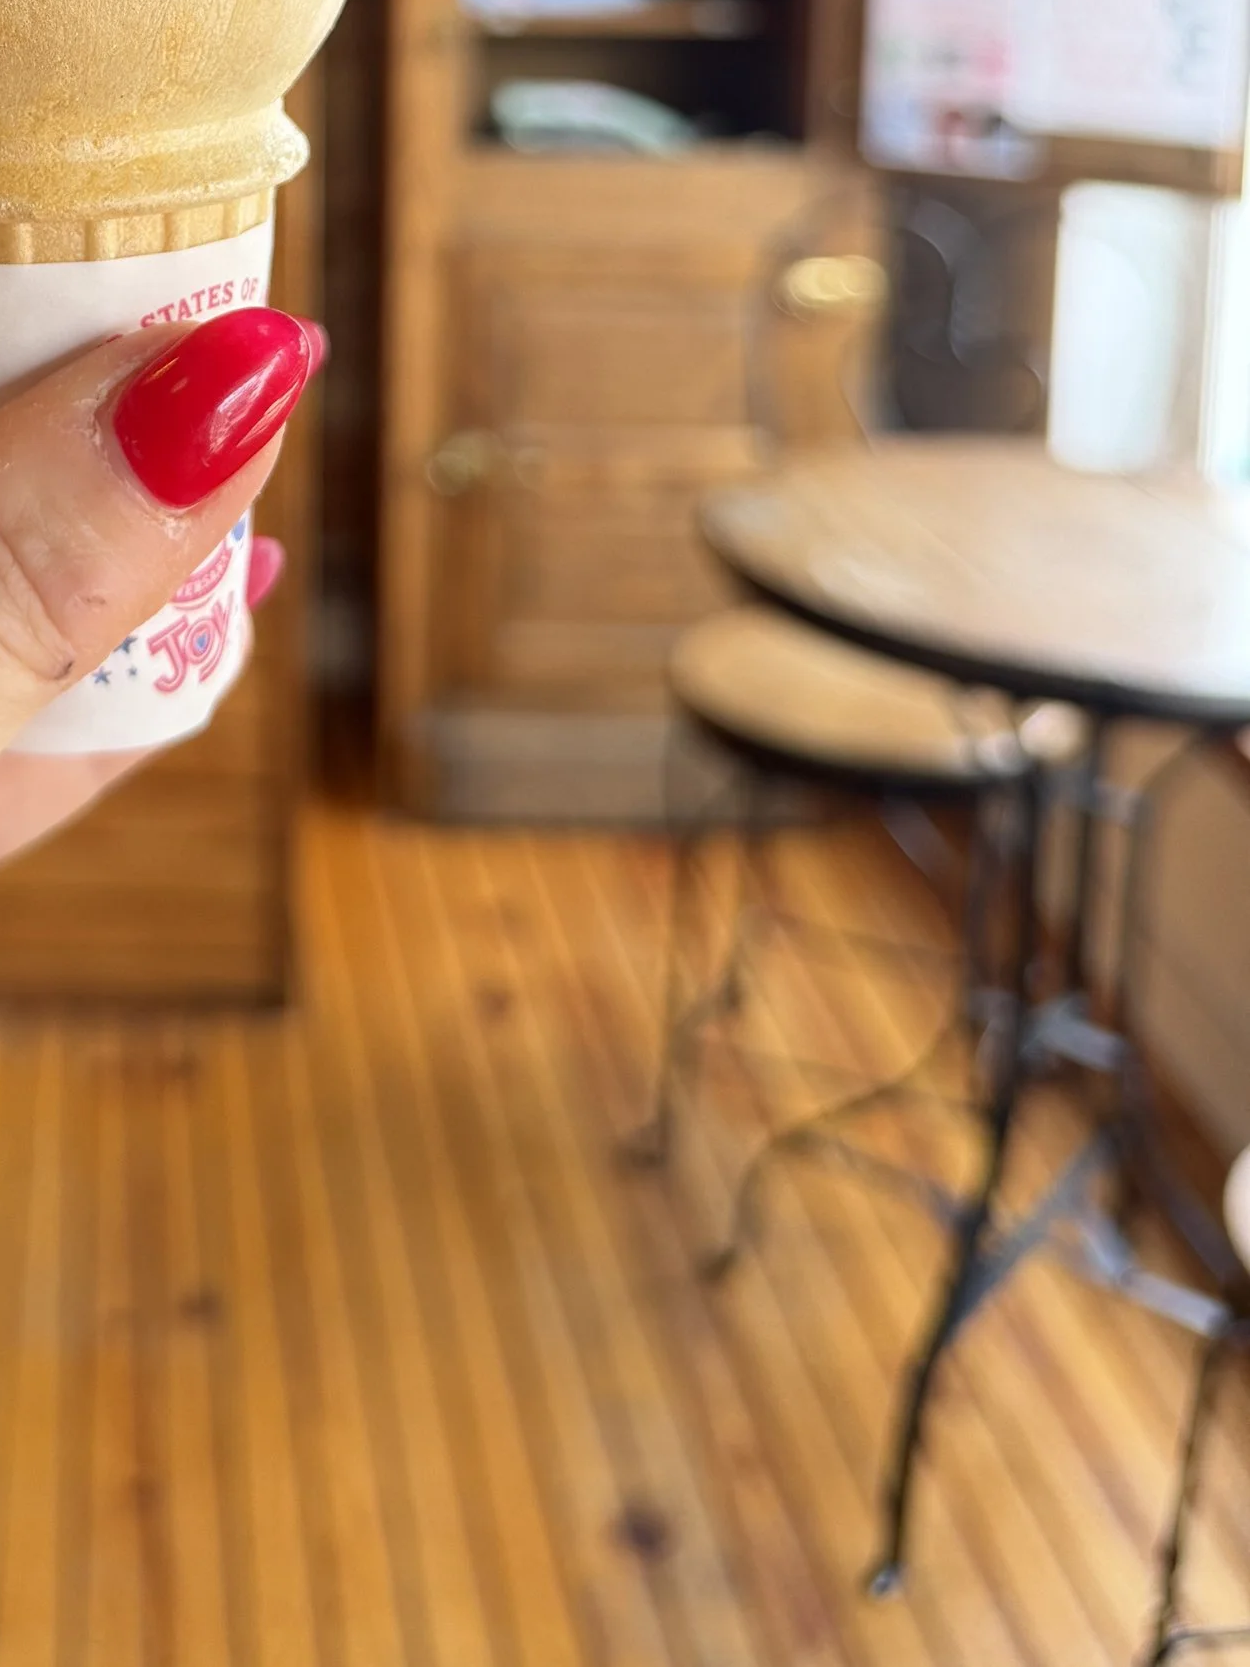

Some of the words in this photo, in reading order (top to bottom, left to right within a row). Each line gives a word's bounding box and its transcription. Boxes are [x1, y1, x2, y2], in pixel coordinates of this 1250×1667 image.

[140, 280, 234, 328] STATES
[241, 277, 259, 301] OF
[147, 590, 235, 695] JOY
